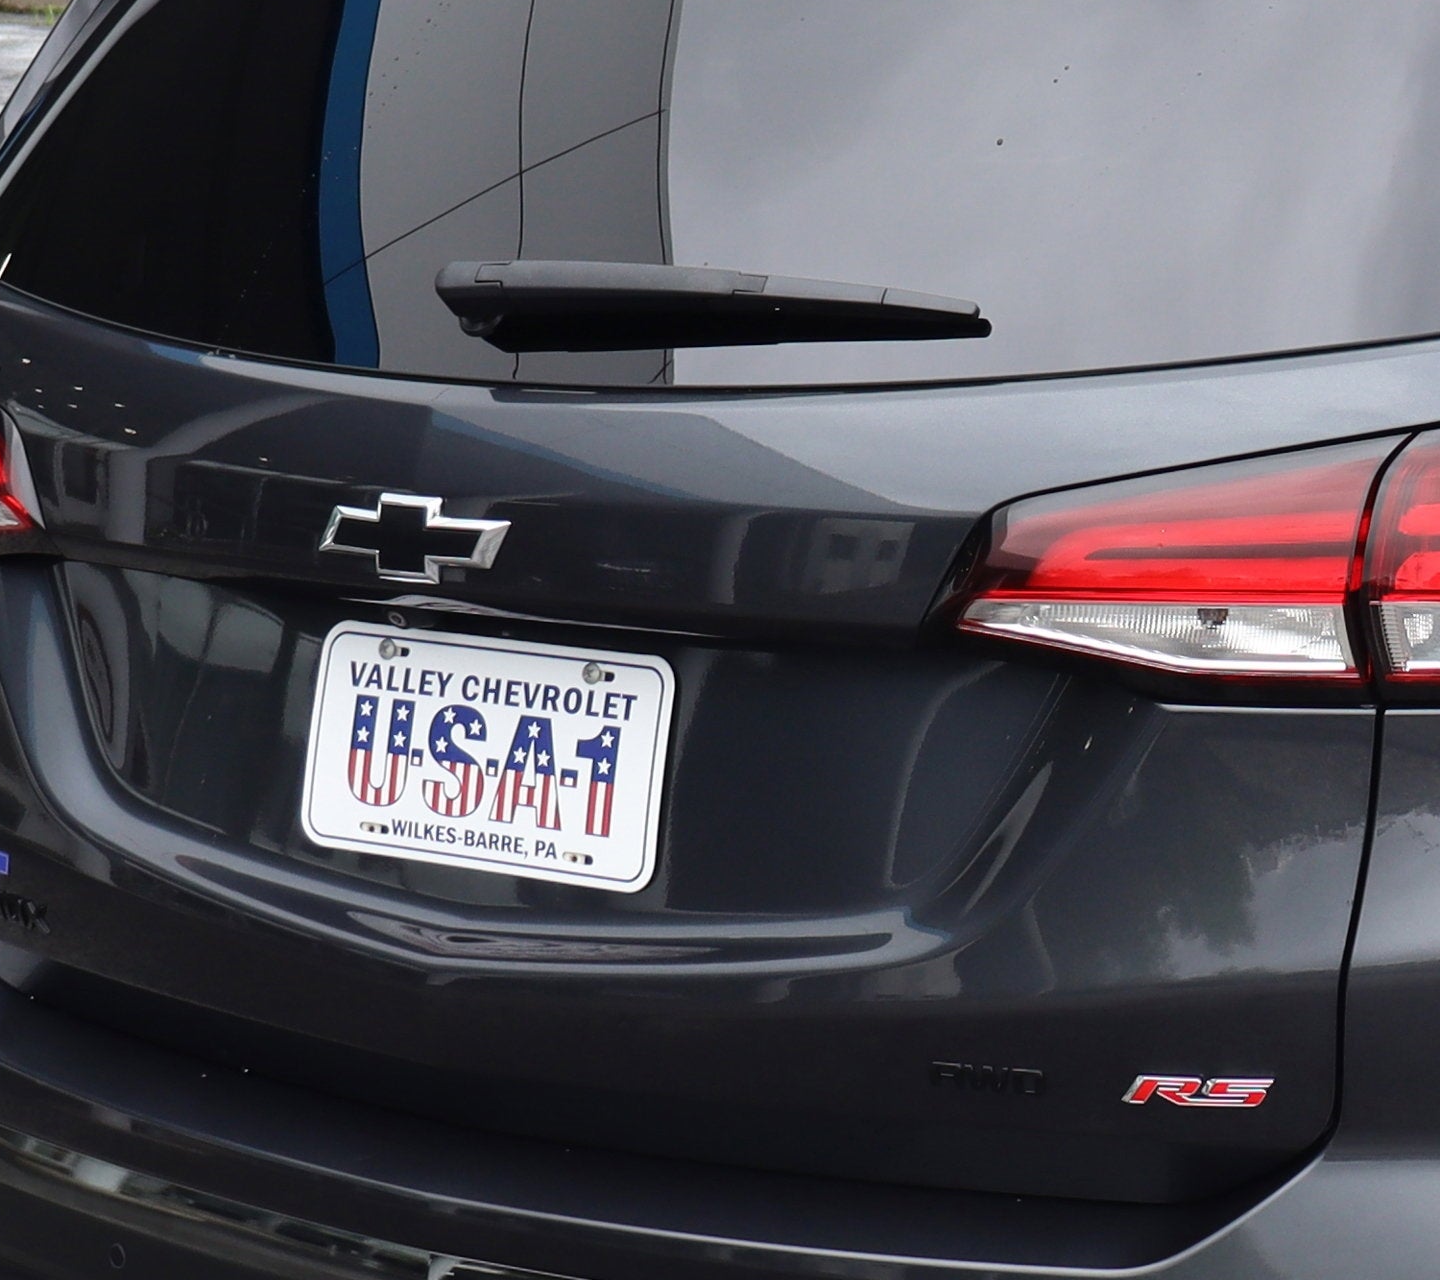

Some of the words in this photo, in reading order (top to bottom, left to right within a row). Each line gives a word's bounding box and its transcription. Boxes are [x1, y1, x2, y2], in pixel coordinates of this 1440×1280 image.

[351, 660, 454, 698] VALLEY
[461, 674, 638, 722] CHEVROLET
[391, 818, 529, 859] WILKES-BARRE,
[534, 840, 558, 860] PA
[1121, 1073, 1274, 1108] RS
